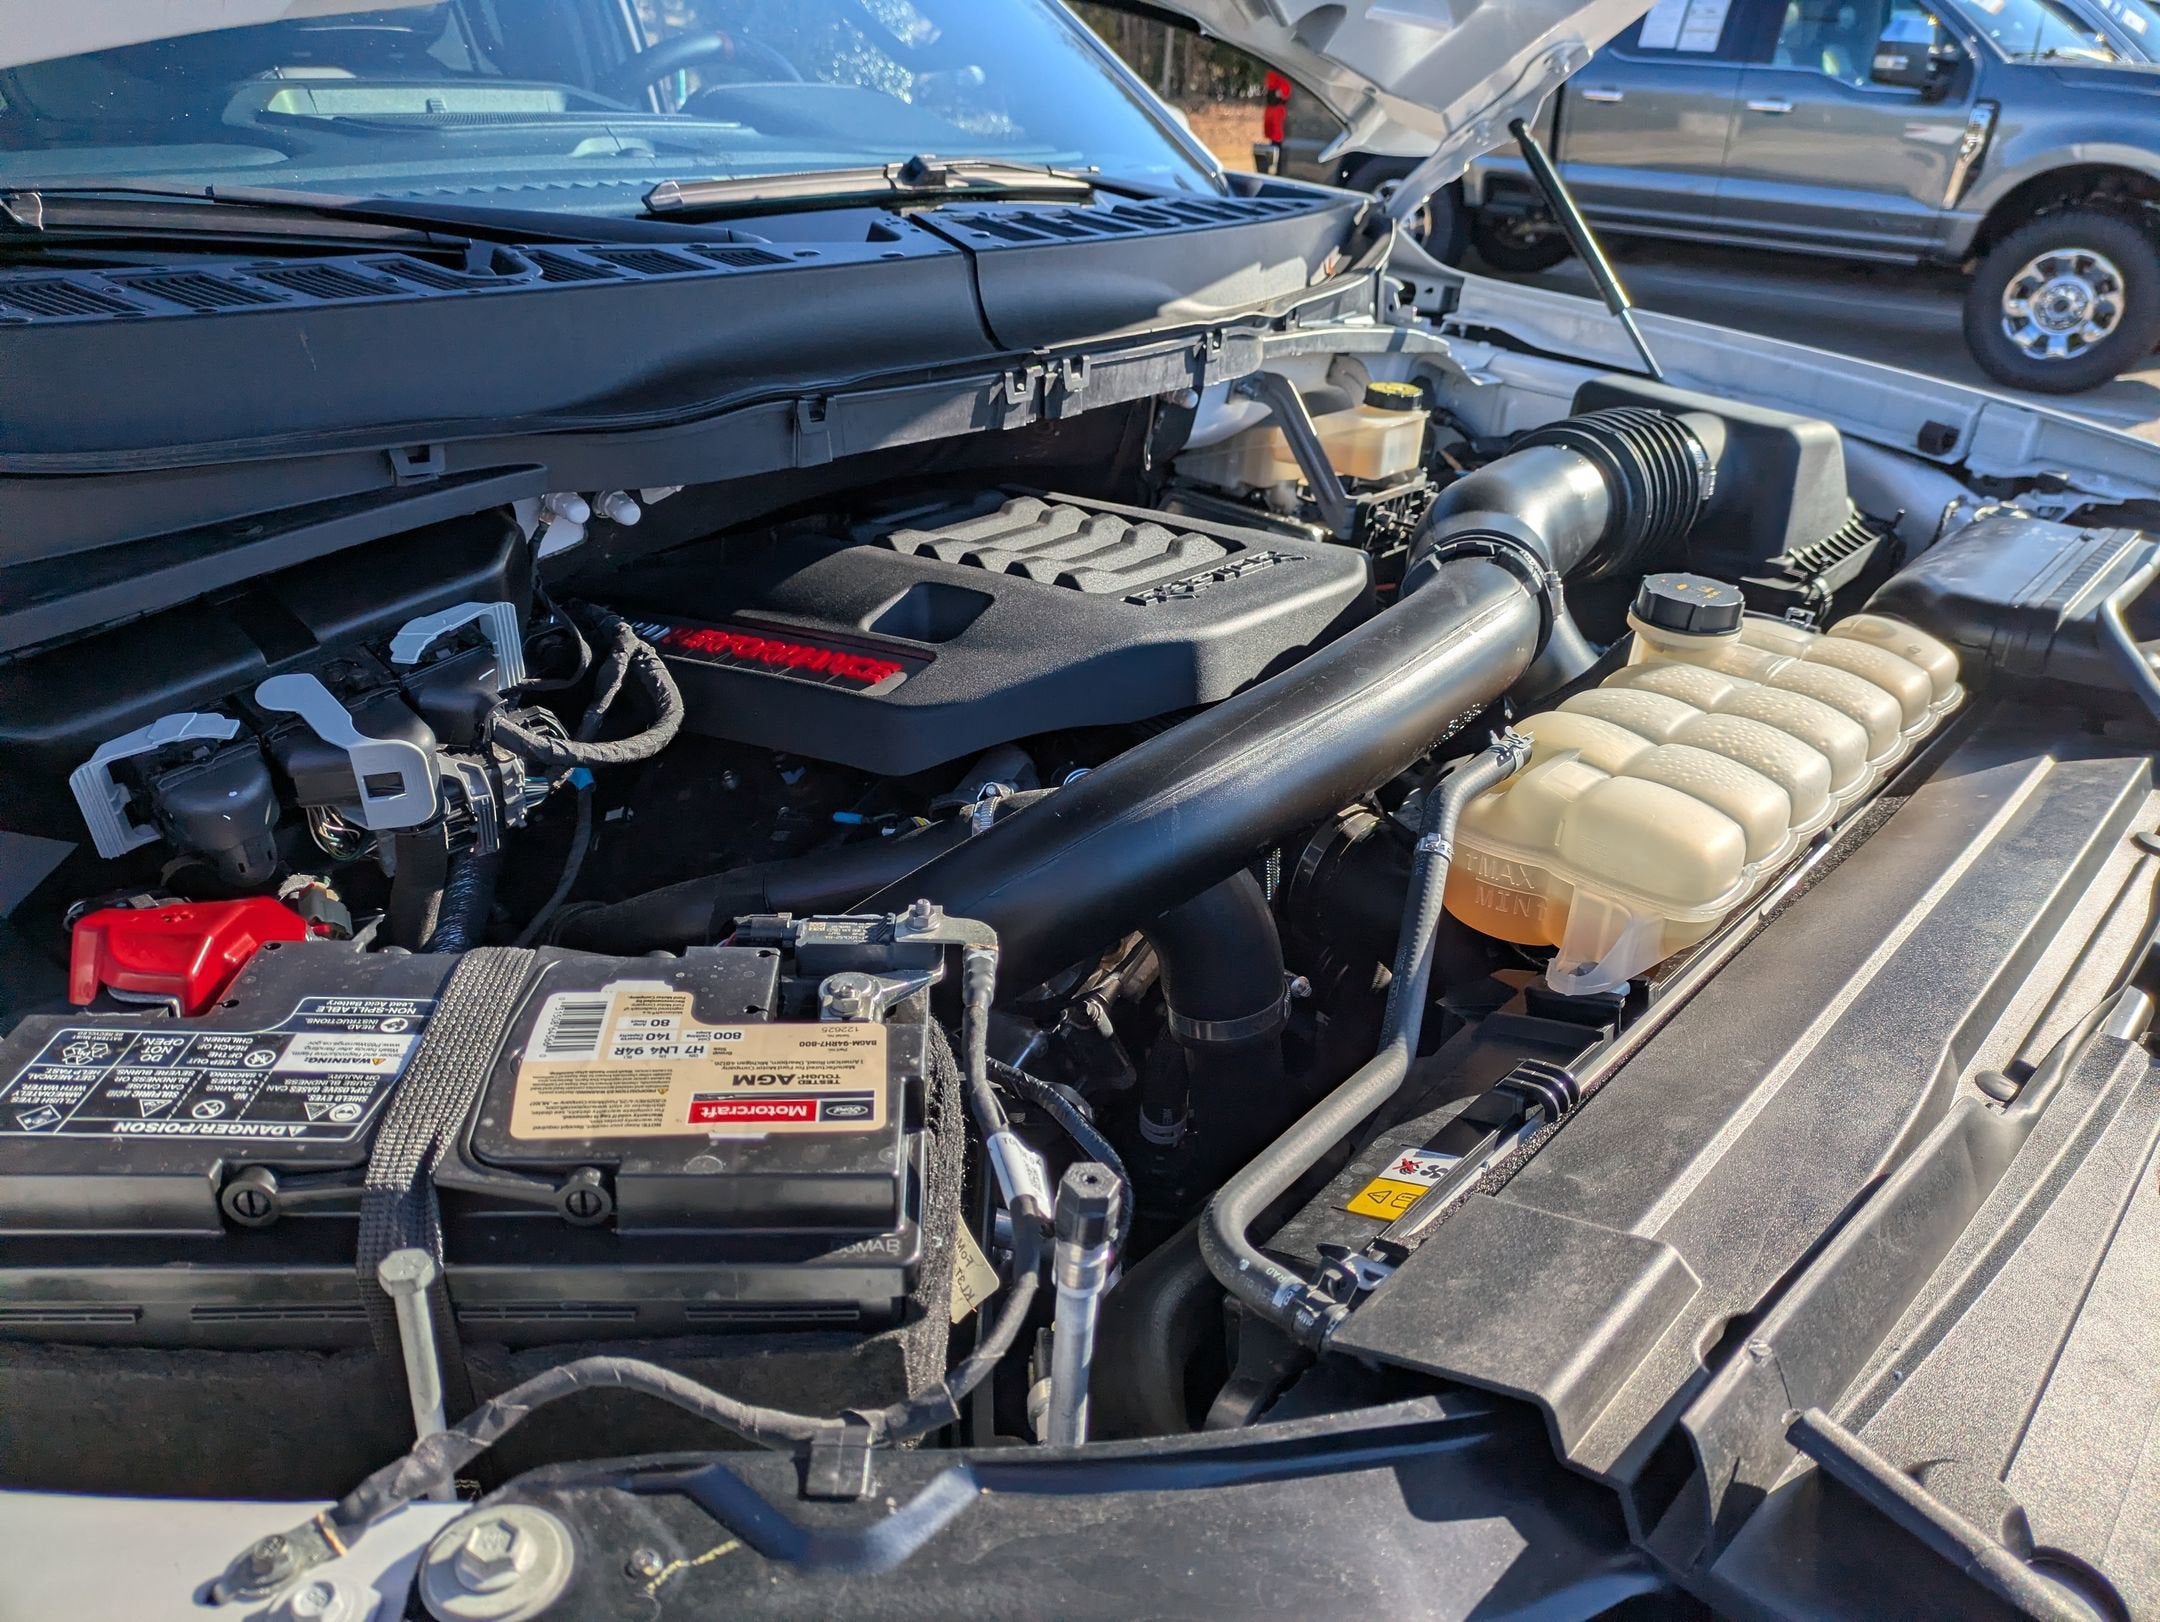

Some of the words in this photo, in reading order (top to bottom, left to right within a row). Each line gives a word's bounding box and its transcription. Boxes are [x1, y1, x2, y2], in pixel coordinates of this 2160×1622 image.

[662, 628, 902, 685] PERFORMANCE
[1478, 856, 1535, 890] MAX
[1474, 885, 1531, 918] MIN
[316, 1006, 417, 1014] NON-SPILLABLE
[714, 1032, 742, 1040] 800
[614, 1047, 644, 1056] 94R
[650, 1046, 678, 1054] LN4
[685, 1046, 704, 1054] H7
[140, 1054, 163, 1062] DO
[28, 1073, 73, 1081] MEDICAL
[732, 1074, 795, 1086] AGM
[132, 1090, 179, 1098] SULFURIC
[322, 1086, 374, 1094] EXPLOSIVE
[701, 1105, 807, 1118] Motorcraft
[832, 1106, 861, 1115] Ford
[112, 1122, 287, 1136] DANGER/POISON
[1265, 1266, 1287, 1283] RAD
